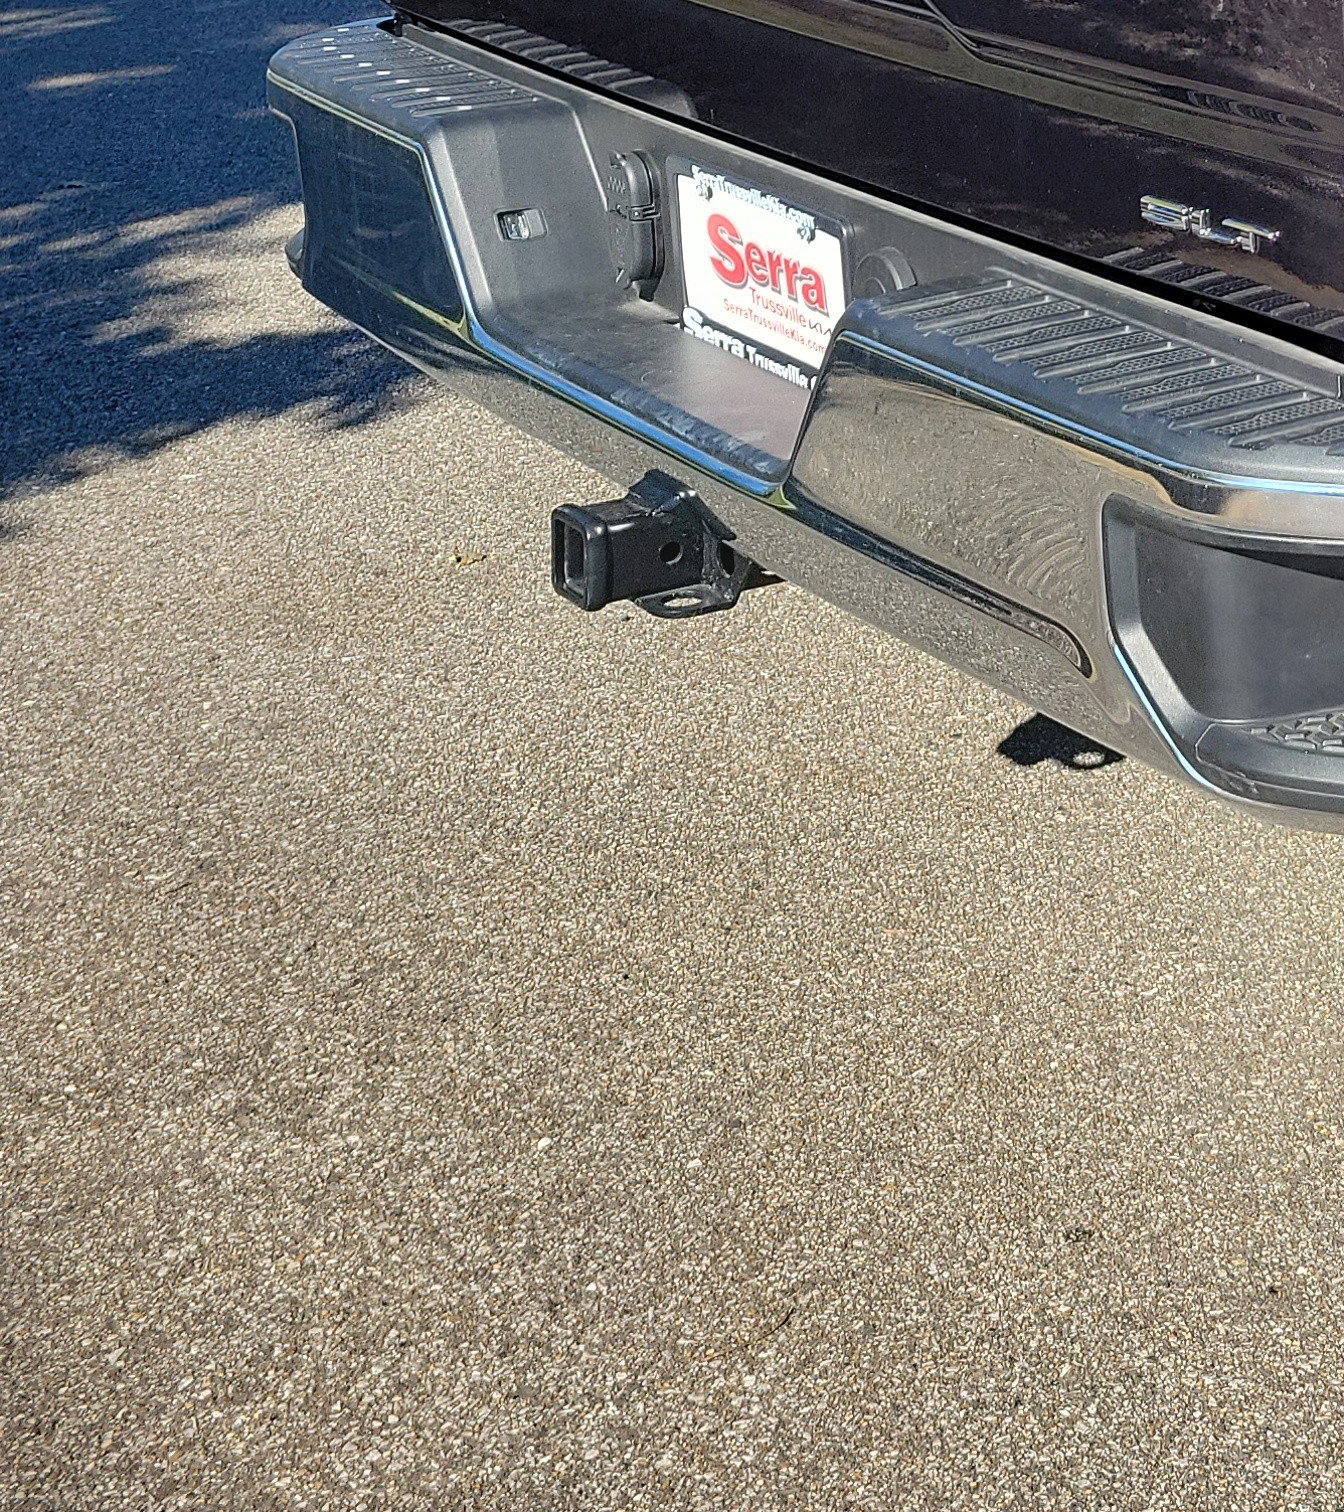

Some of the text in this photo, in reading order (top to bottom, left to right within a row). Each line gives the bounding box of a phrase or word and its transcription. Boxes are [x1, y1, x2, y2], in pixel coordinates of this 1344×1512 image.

[1140, 194, 1281, 254] SLT
[707, 213, 829, 317] Serra
[682, 306, 745, 359] Serra
[749, 286, 807, 327] Trussville
